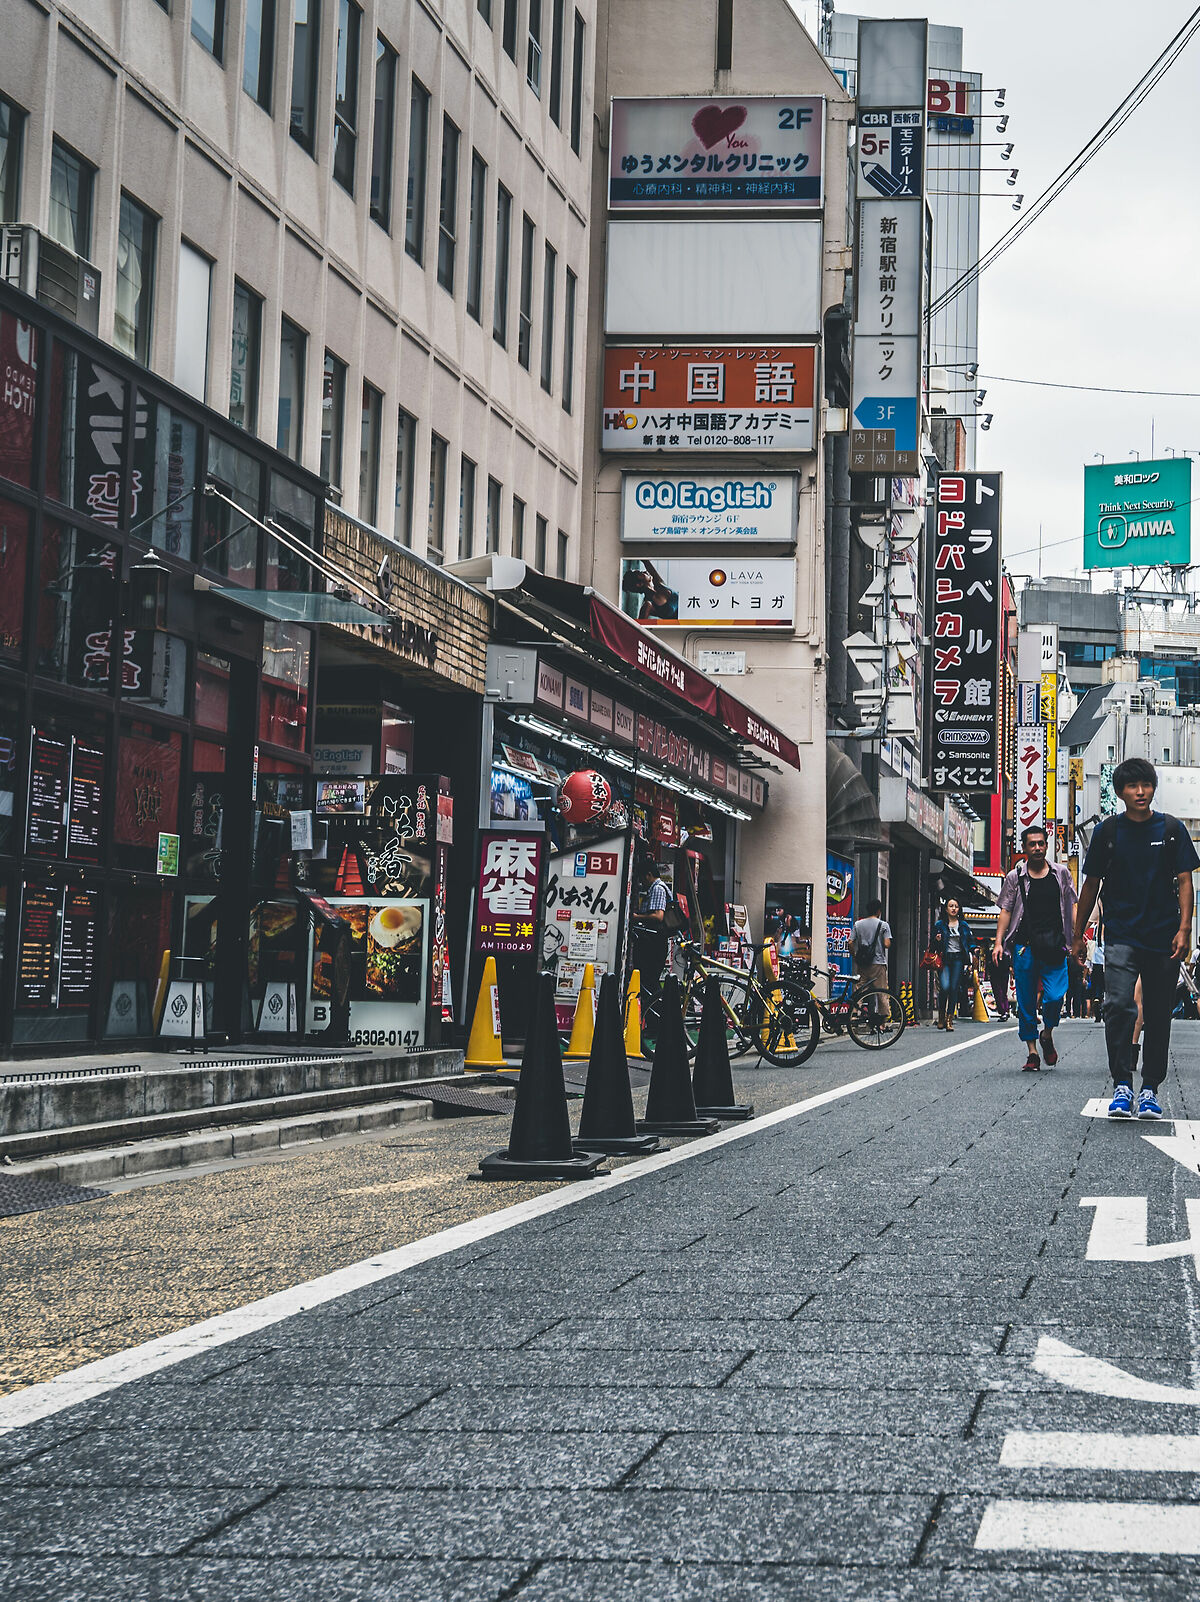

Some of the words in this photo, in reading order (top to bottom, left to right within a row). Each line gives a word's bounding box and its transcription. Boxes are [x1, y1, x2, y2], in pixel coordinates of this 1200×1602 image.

[778, 108, 813, 130] 2F
[862, 113, 889, 125] CBR
[893, 112, 920, 125] 西新宿
[726, 133, 749, 148] You
[861, 133, 890, 156] 5F
[621, 154, 810, 175] ゆうメンタルクリニック
[900, 128, 914, 195] モニタールーム
[633, 182, 796, 196] 心療内科・精神科・神経内科
[878, 216, 898, 381] 新宿駅前クリニック
[636, 349, 782, 360] マン・ツー・マン・レッスン
[642, 412, 810, 432] ハオ中国語アカデミー
[876, 405, 896, 421] 3F
[643, 434, 680, 446] 新宿校
[687, 435, 702, 445] Tel
[704, 435, 774, 446] 0120-808-117
[854, 430, 888, 444] 内科
[1114, 472, 1160, 486] 美和ロック
[677, 481, 773, 513] English
[1099, 502, 1122, 514] Think
[1123, 501, 1141, 512] Next
[1142, 498, 1175, 511] Security
[672, 514, 723, 523] 新宿ラウンジ
[726, 515, 740, 523] 6F
[652, 526, 689, 535] セブ島留学
[699, 526, 758, 535] オンライン英会話
[1128, 520, 1176, 539] MIWA
[730, 571, 764, 580] LAVA
[933, 477, 967, 706] ヨドバシカメラ
[963, 478, 995, 707] トラベル館
[687, 595, 785, 609] ホットヨガ
[637, 640, 671, 683] ヨドバシカメラ
[540, 672, 563, 698] KONAMI
[569, 686, 585, 712] SEGA
[616, 711, 633, 733] SONY
[944, 731, 985, 743] RIMOWA
[637, 713, 689, 770] ヨドバシカメラ
[688, 743, 710, 782] ゲーム館
[949, 751, 990, 759] Samsonite
[933, 766, 993, 786] すぐここ
[1019, 745, 1042, 827] ラーメン
[590, 857, 613, 871] B1
[482, 838, 537, 916] 麻雀
[545, 874, 615, 915] かあさん
[493, 922, 534, 937] 三洋
